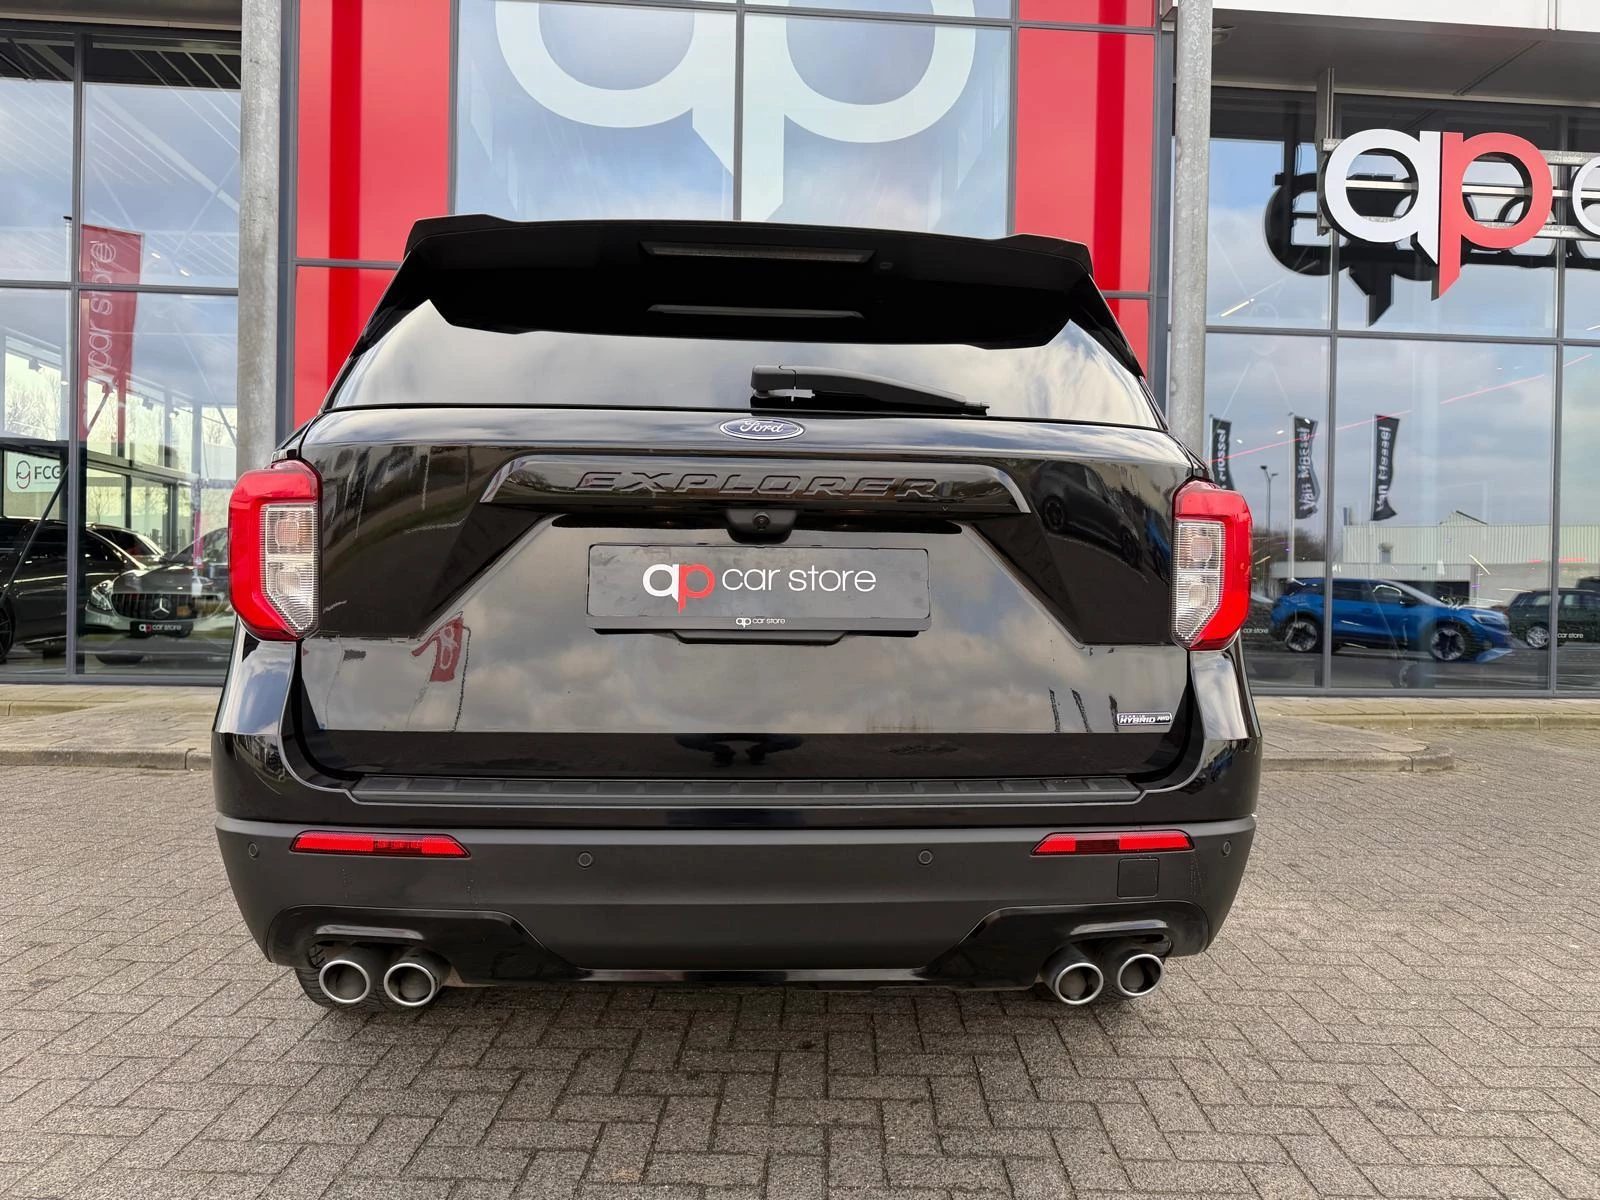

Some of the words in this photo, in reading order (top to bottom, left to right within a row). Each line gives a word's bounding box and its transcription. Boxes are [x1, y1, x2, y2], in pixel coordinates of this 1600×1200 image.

[740, 421, 784, 433] Ford
[574, 471, 939, 498] EXPLORER
[722, 568, 781, 591] car
[788, 565, 877, 592] store
[1120, 716, 1156, 724] HYBRID
